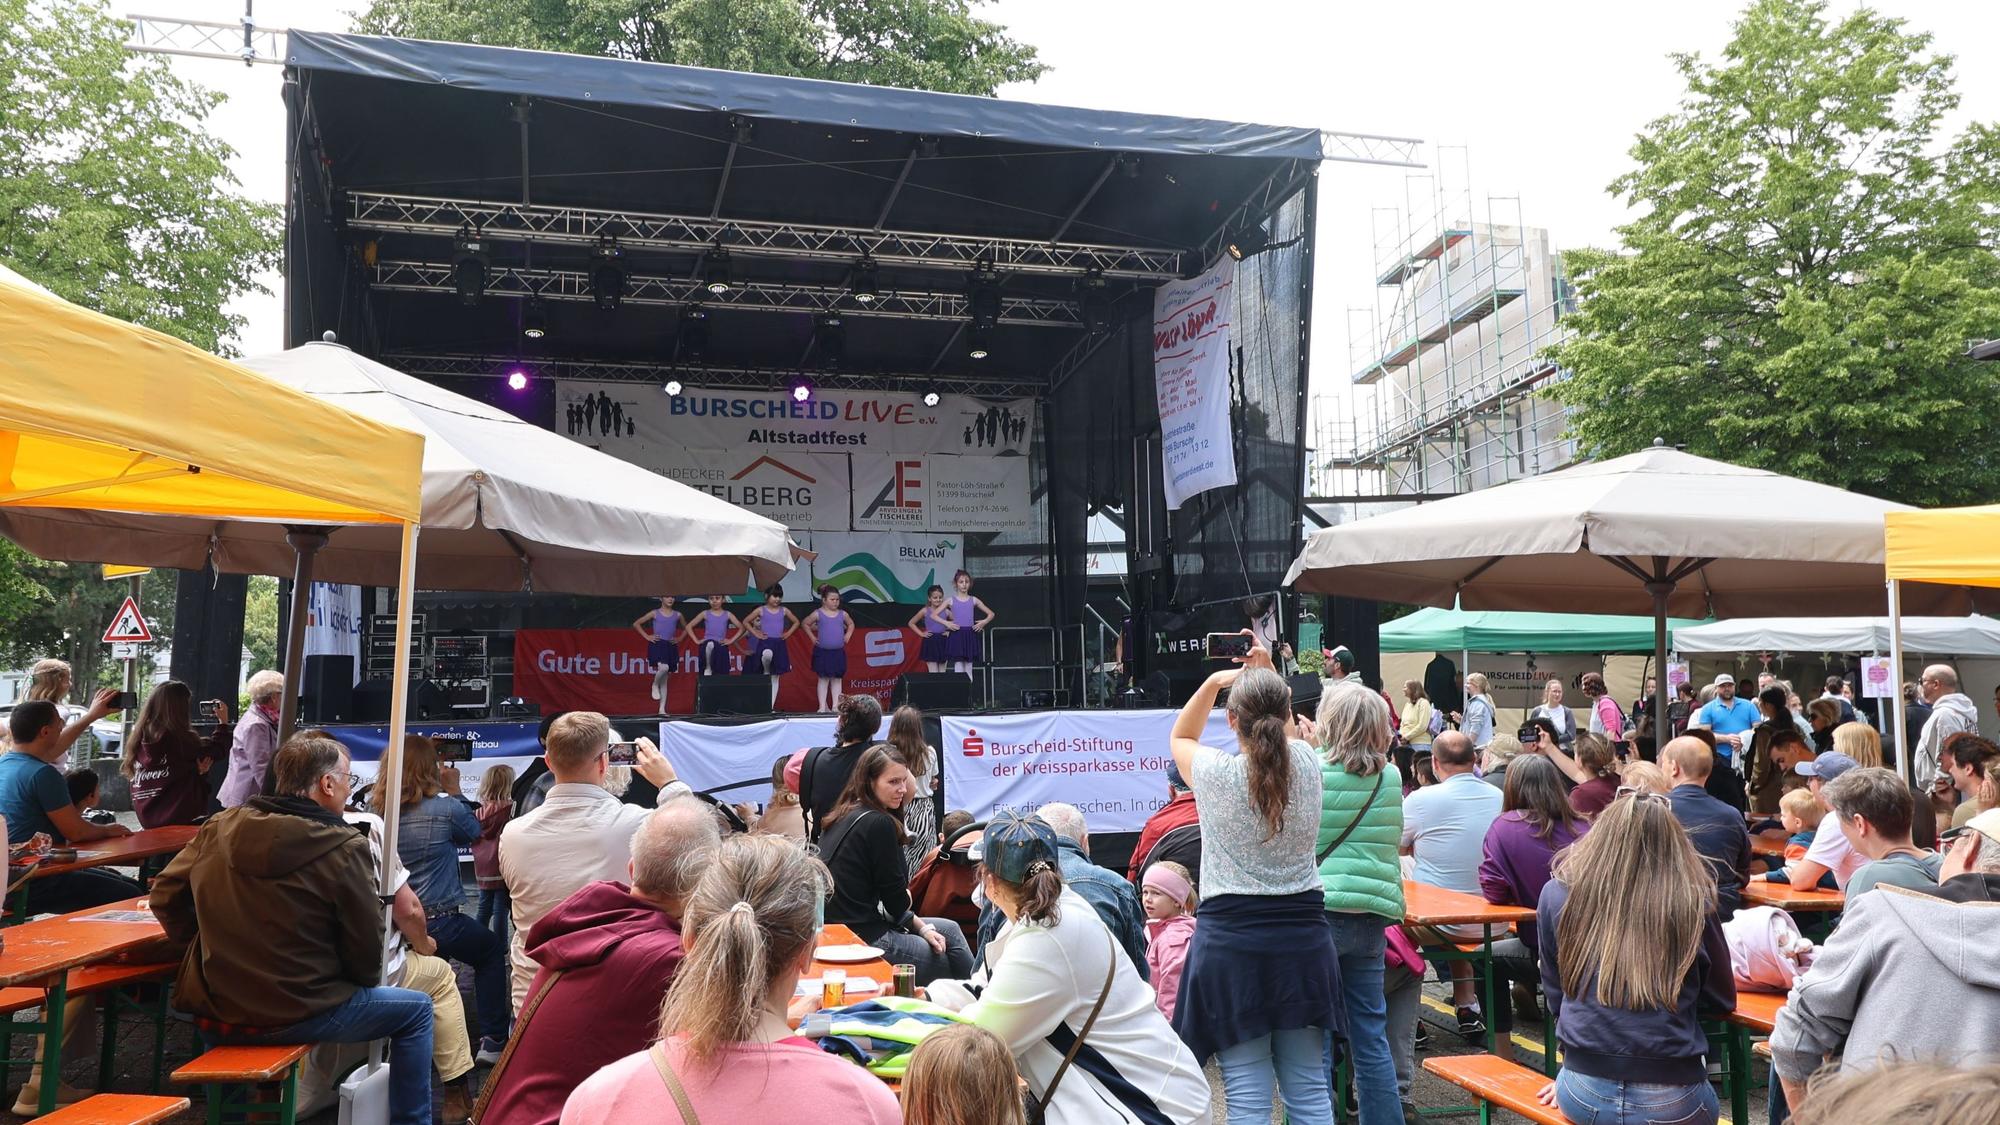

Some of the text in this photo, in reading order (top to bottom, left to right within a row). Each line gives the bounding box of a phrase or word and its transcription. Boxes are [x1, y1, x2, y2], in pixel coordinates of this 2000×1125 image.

[670, 397, 839, 420] BURSCHEID
[845, 400, 915, 425] LIVE
[748, 429, 867, 446] Altstadtfest
[648, 466, 725, 480] CHDECKER
[937, 505, 964, 513] Telefon
[899, 547, 945, 558] BELKAW
[538, 649, 601, 675] Gute
[1483, 671, 1533, 680] URSCHEID
[991, 737, 1133, 756] Burscheid-Stiftung
[992, 763, 1017, 777] der
[1023, 759, 1135, 777] Kreissparkasse
[1131, 798, 1144, 812] In
